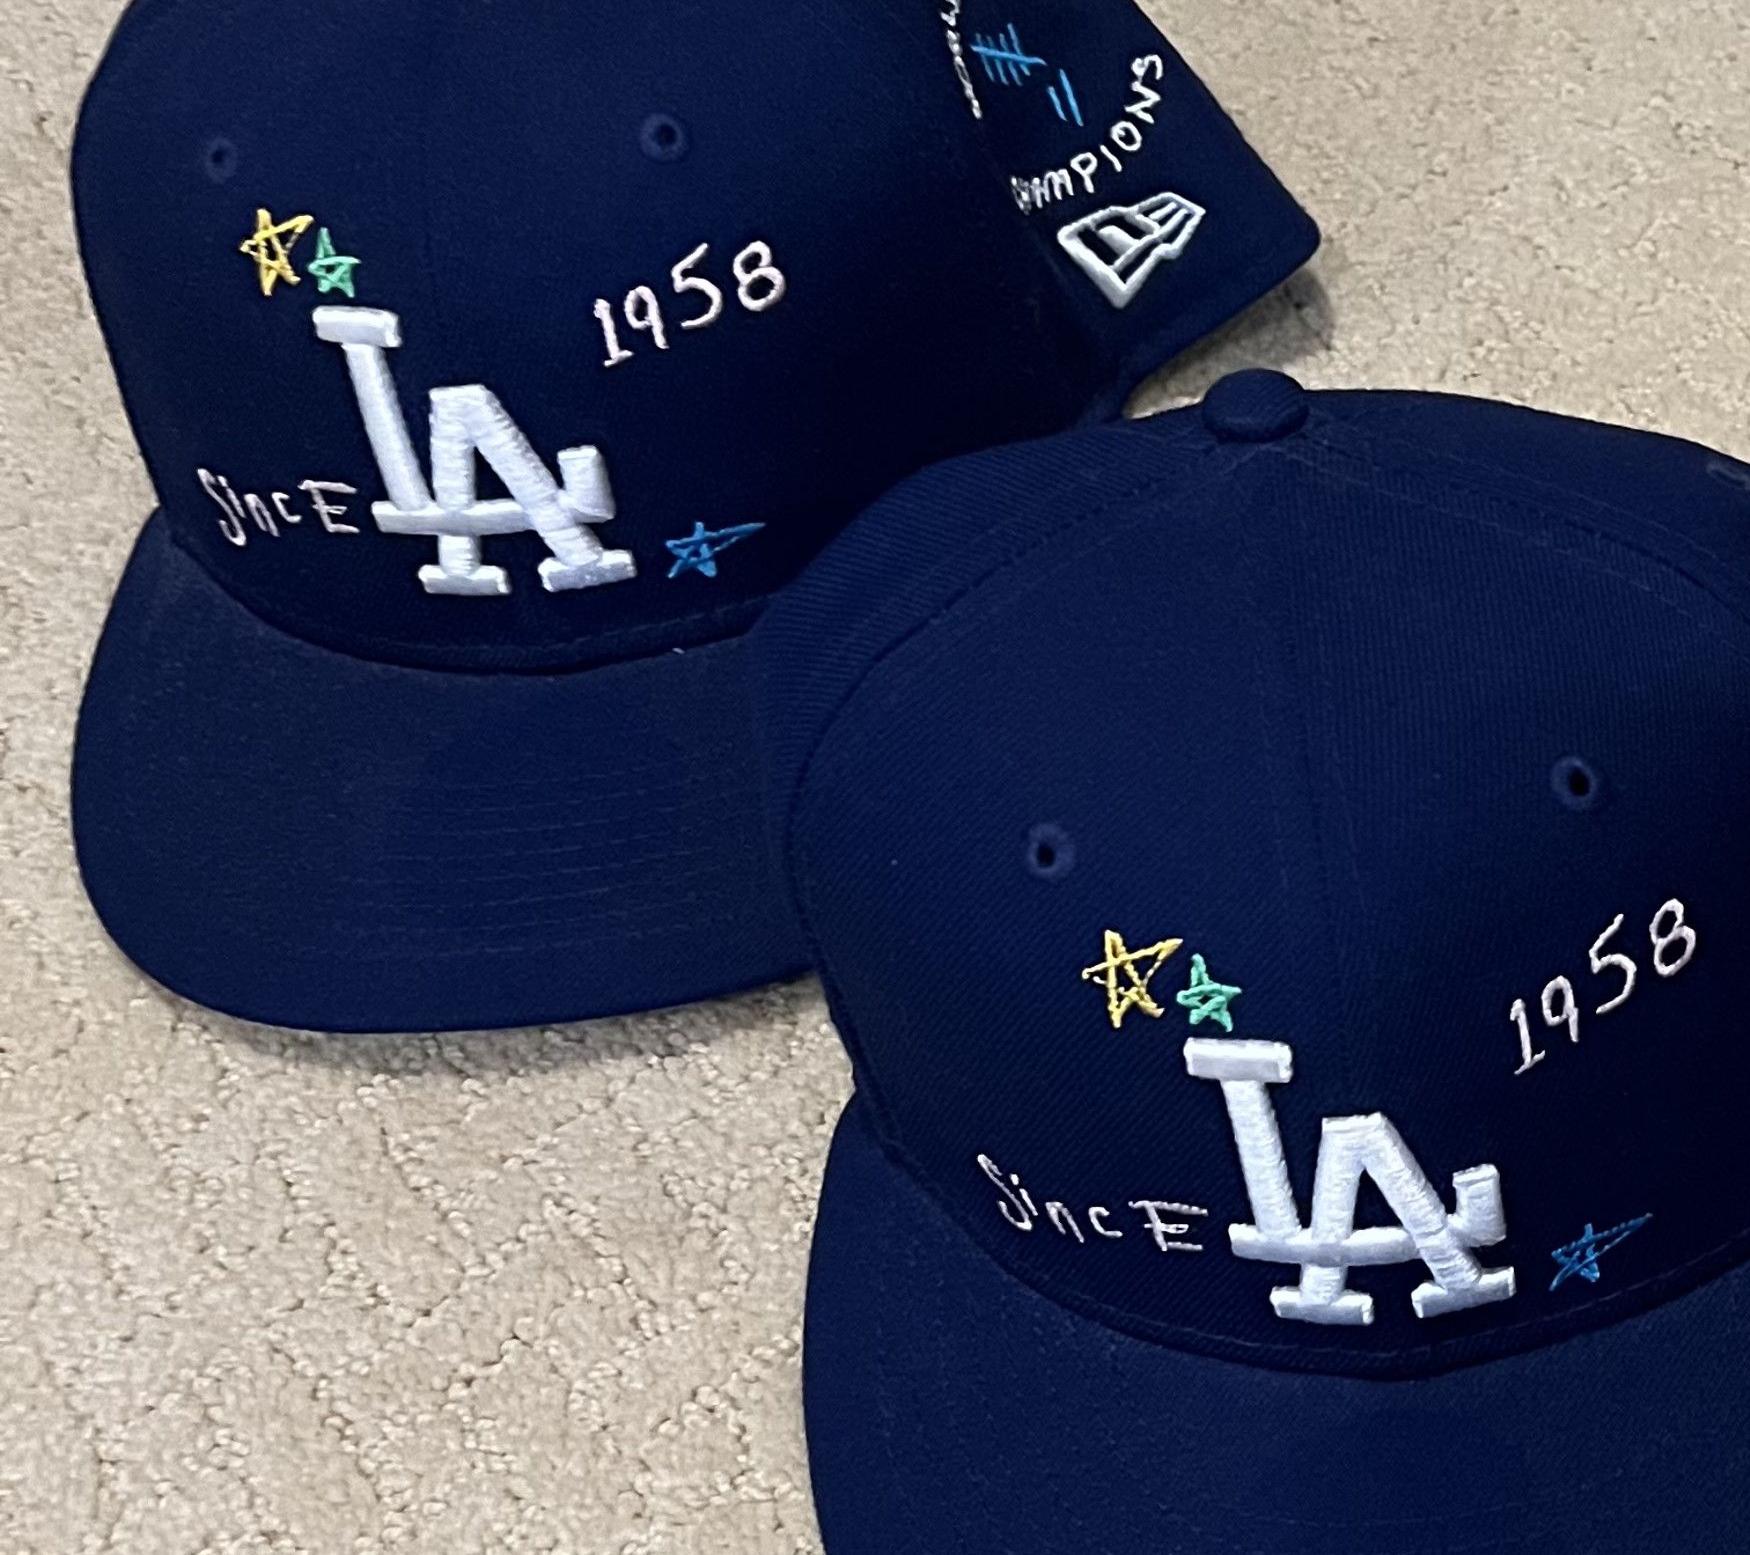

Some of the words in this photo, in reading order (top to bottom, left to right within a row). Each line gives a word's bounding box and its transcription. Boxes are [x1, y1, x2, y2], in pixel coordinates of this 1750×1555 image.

[593, 240, 787, 368] 1958
[312, 305, 638, 597] LA
[1506, 896, 1699, 1078] 1958
[1183, 1037, 1518, 1326] LA
